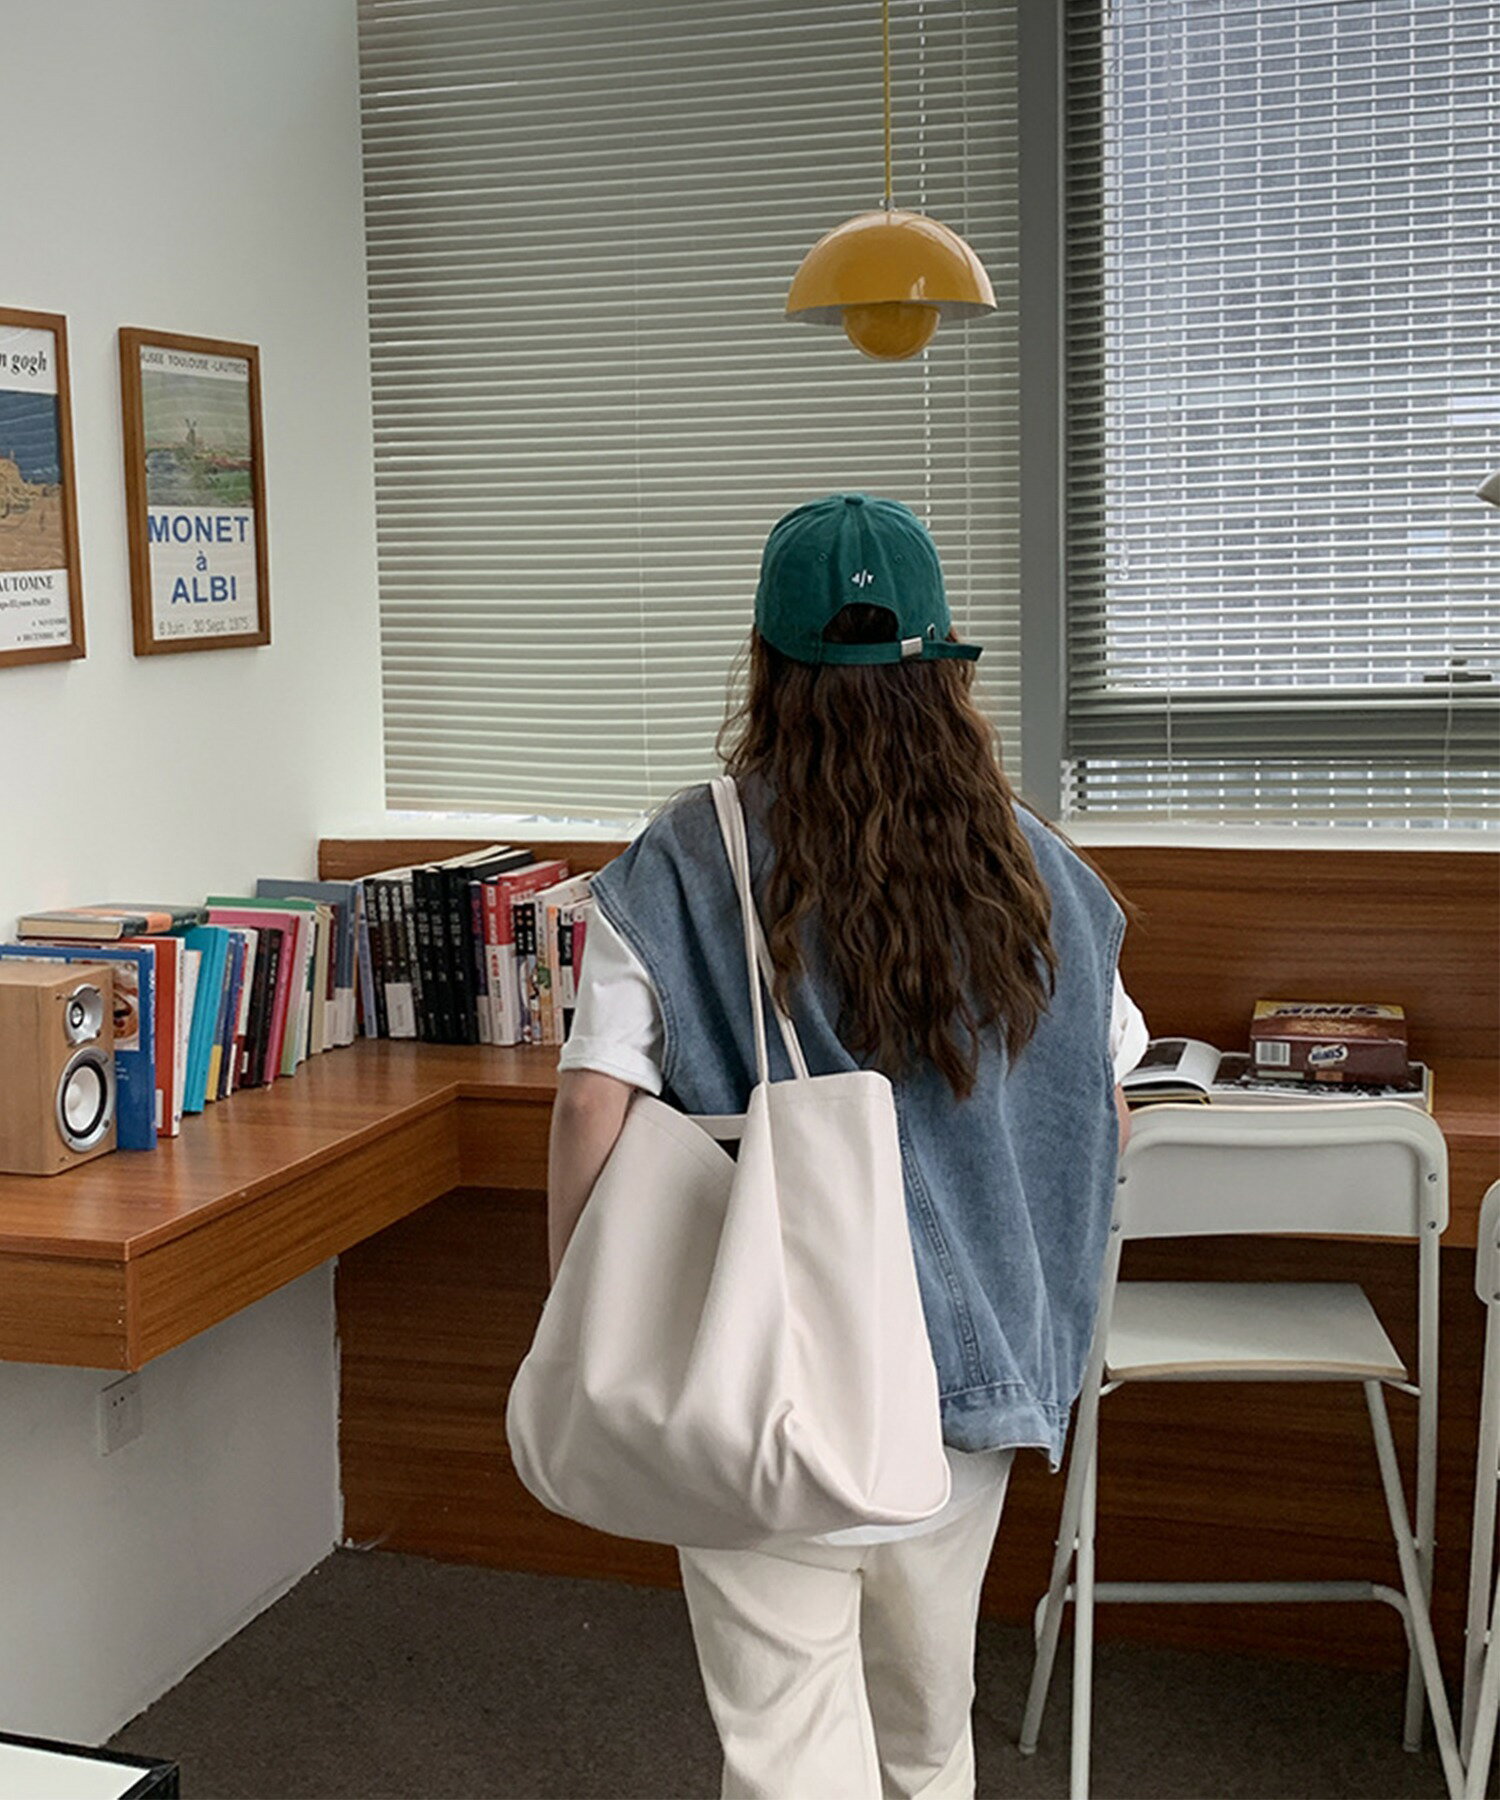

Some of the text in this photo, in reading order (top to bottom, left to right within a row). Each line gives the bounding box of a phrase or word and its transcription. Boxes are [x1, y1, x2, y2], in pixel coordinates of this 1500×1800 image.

[11, 350, 47, 376] gogh
[148, 515, 249, 543] MONET
[196, 550, 208, 572] à
[171, 576, 237, 604] ALBI
